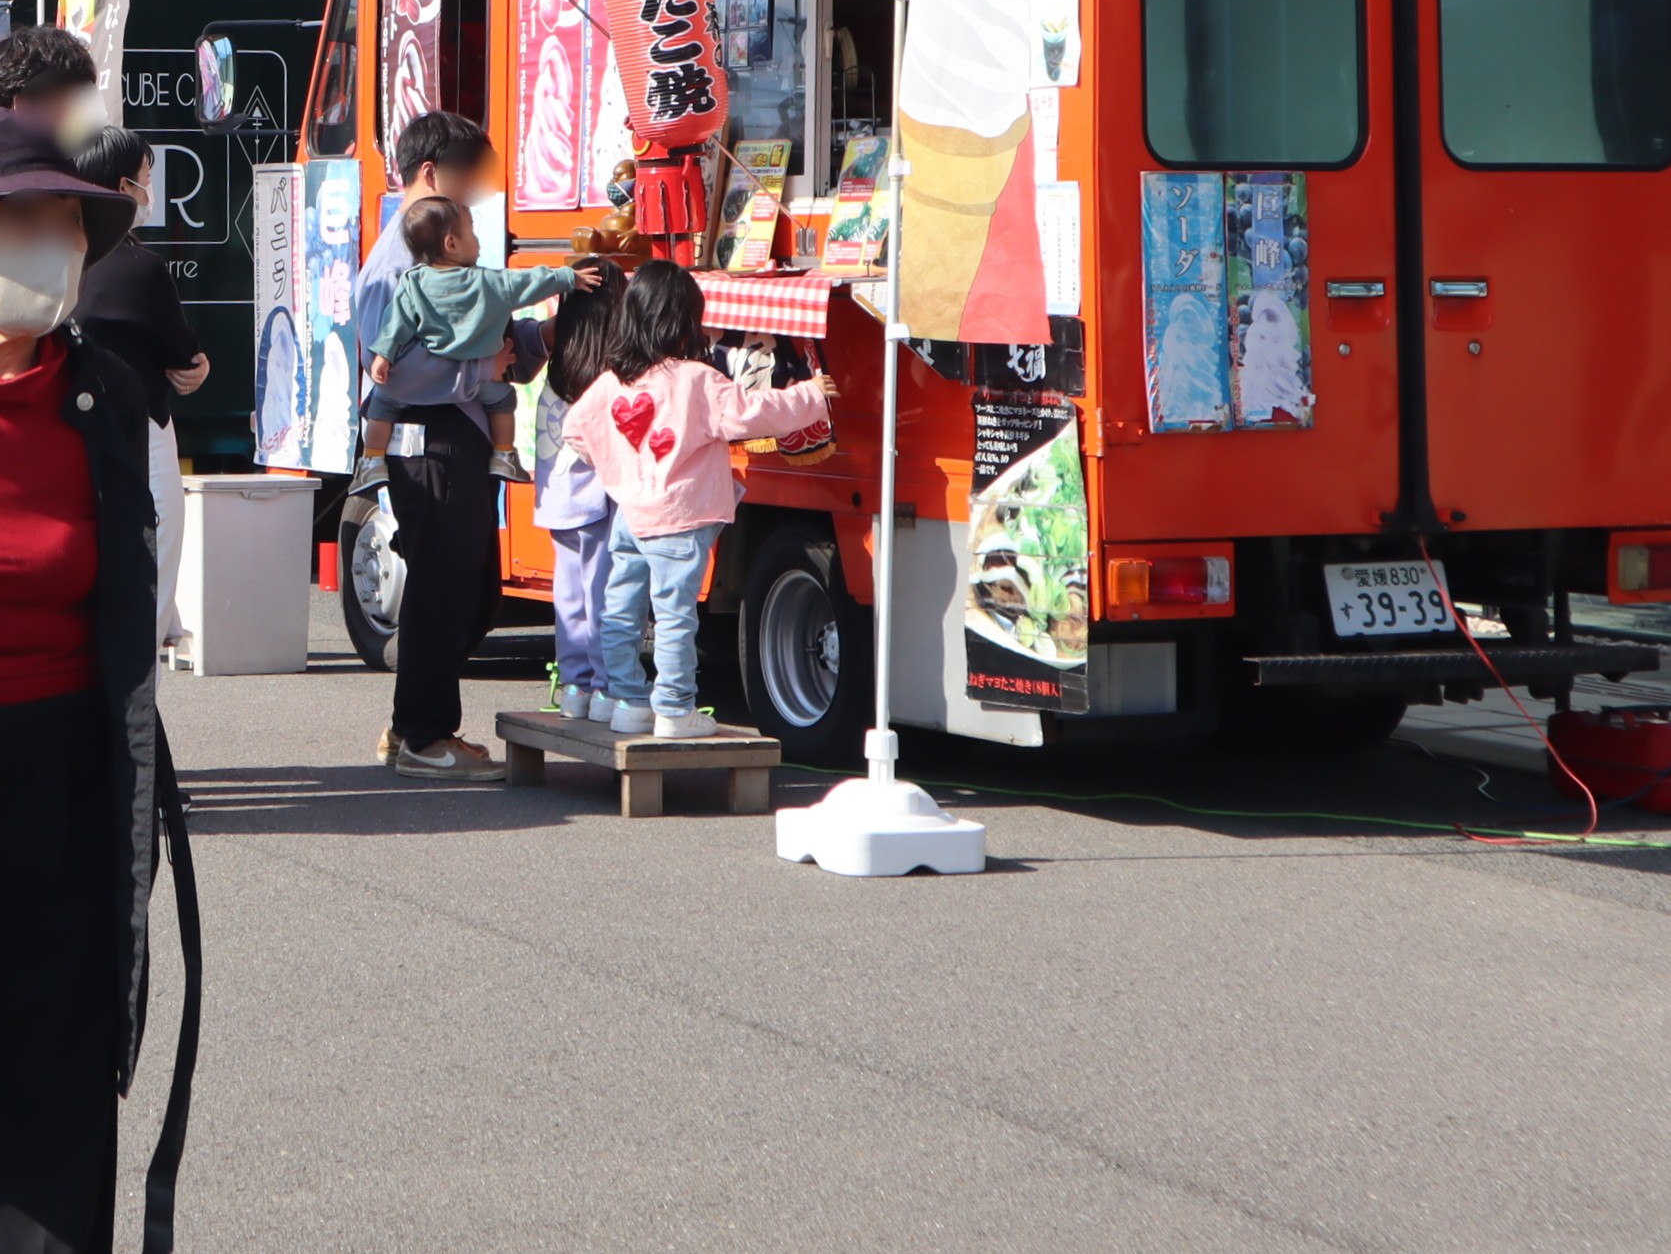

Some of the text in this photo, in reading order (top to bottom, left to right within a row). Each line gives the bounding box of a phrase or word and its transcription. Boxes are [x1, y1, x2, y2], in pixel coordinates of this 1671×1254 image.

[176, 73, 196, 107] C
[270, 177, 288, 301] バニラ
[1171, 184, 1198, 278] ソーダ
[1255, 192, 1280, 270] 巨峰
[167, 259, 199, 278] rre
[1340, 590, 1447, 628] す 39-39
